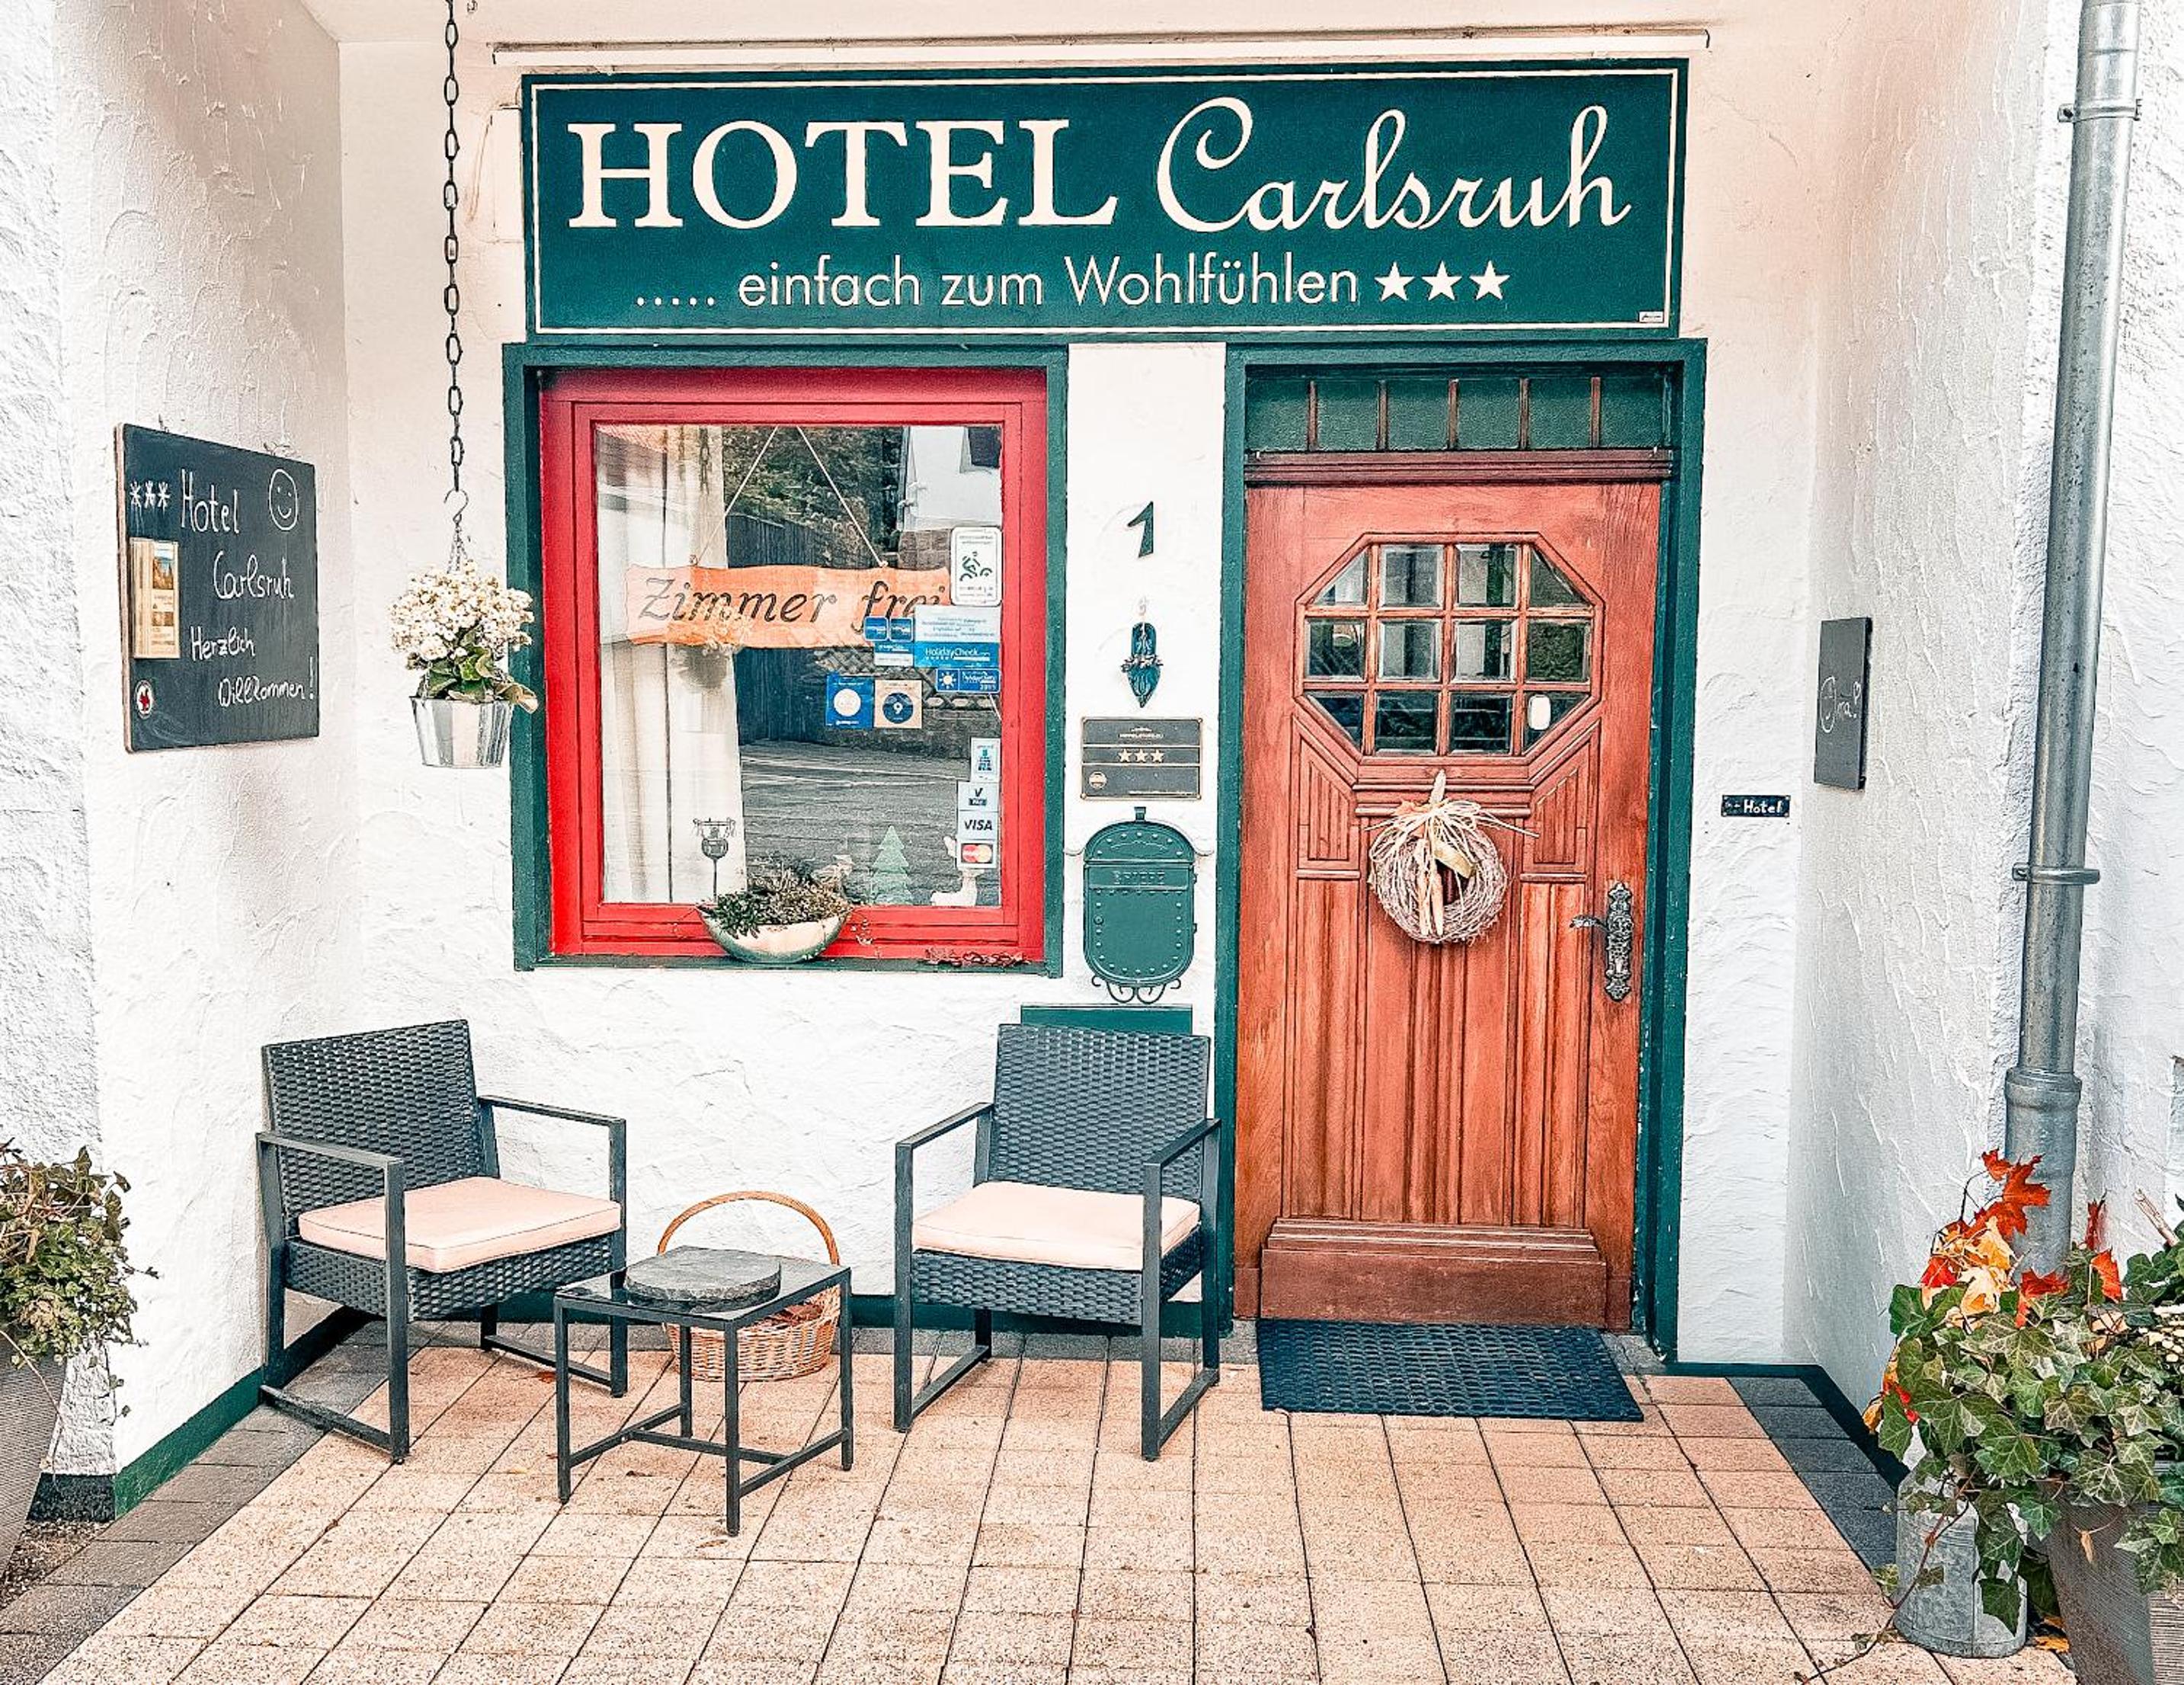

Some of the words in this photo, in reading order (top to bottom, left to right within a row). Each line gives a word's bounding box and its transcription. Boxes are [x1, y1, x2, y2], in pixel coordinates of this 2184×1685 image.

[567, 118, 1118, 229] HOTEL
[1156, 96, 1632, 232] Carlsruh
[738, 254, 921, 306] einfach
[941, 273, 1042, 306] zum
[1065, 251, 1357, 306] Wohlfühlen
[181, 469, 239, 534] Hotel
[1128, 501, 1154, 558] 1
[213, 549, 295, 601] Carlsruh
[639, 577, 837, 623] Zimmer
[191, 626, 256, 661] Herzlich
[964, 820, 993, 831] VISA
[1743, 799, 1782, 813] Hotel
